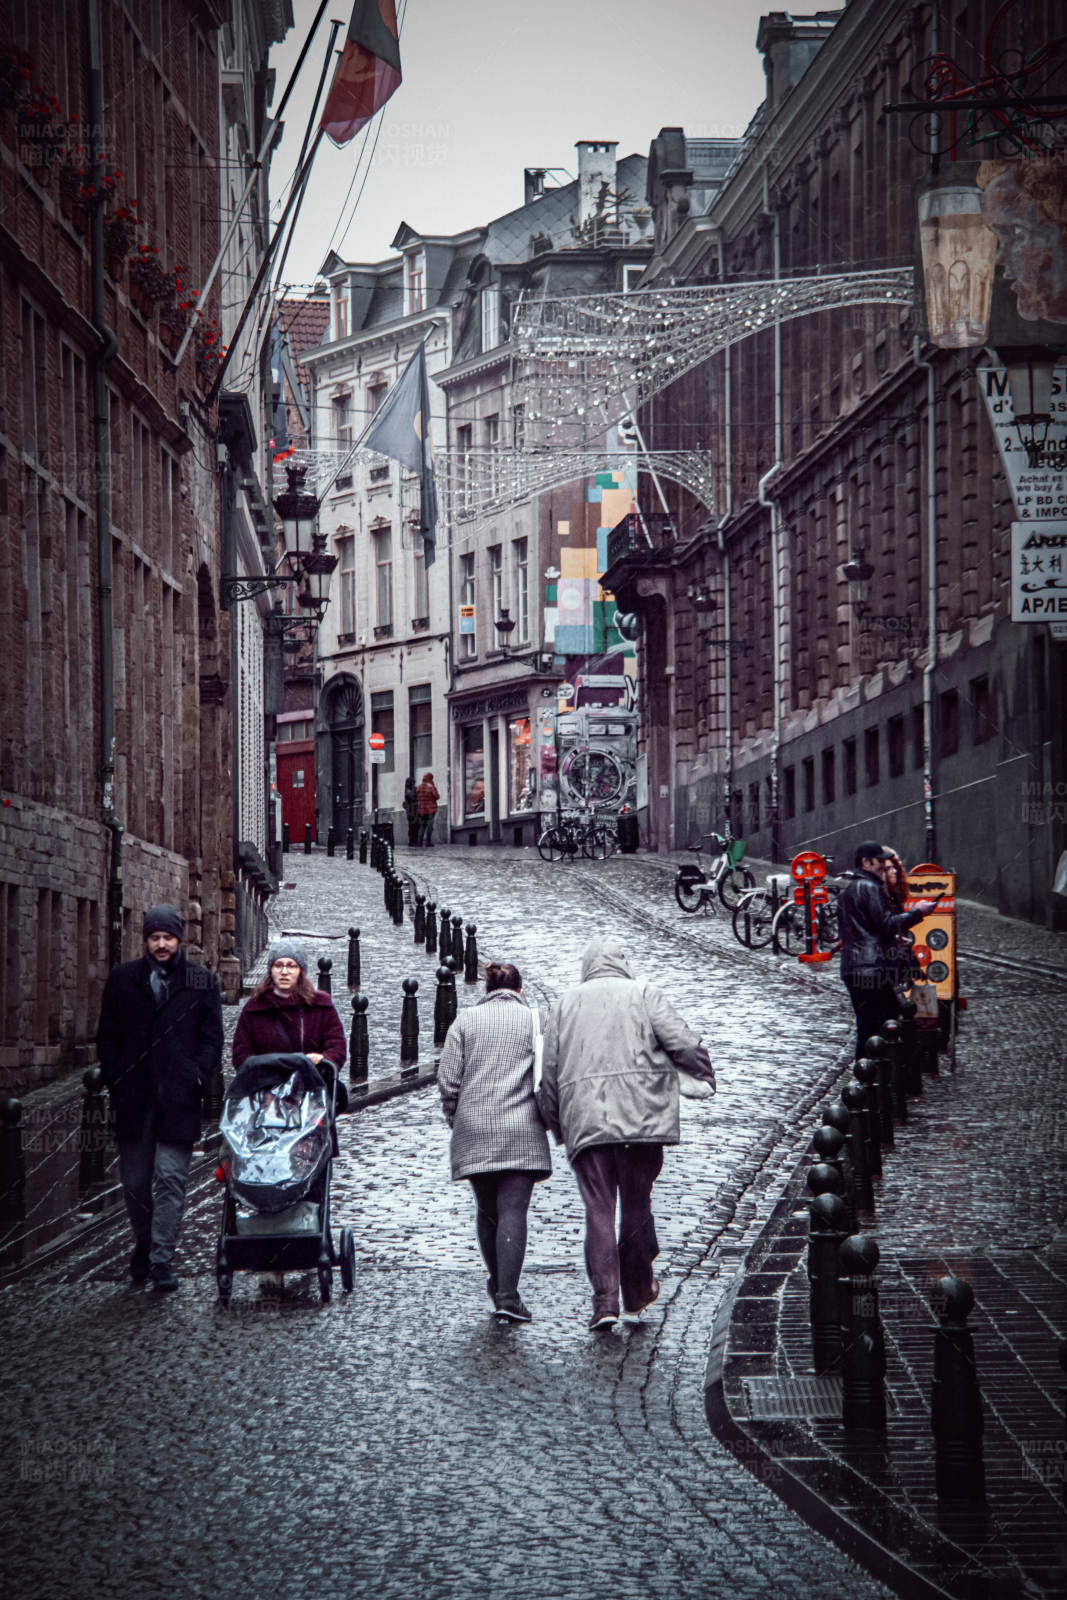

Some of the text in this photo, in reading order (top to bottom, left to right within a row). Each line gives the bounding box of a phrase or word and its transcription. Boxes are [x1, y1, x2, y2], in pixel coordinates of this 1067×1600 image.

[1017, 495, 1067, 505] LP BD C
[1022, 508, 1031, 518] &
